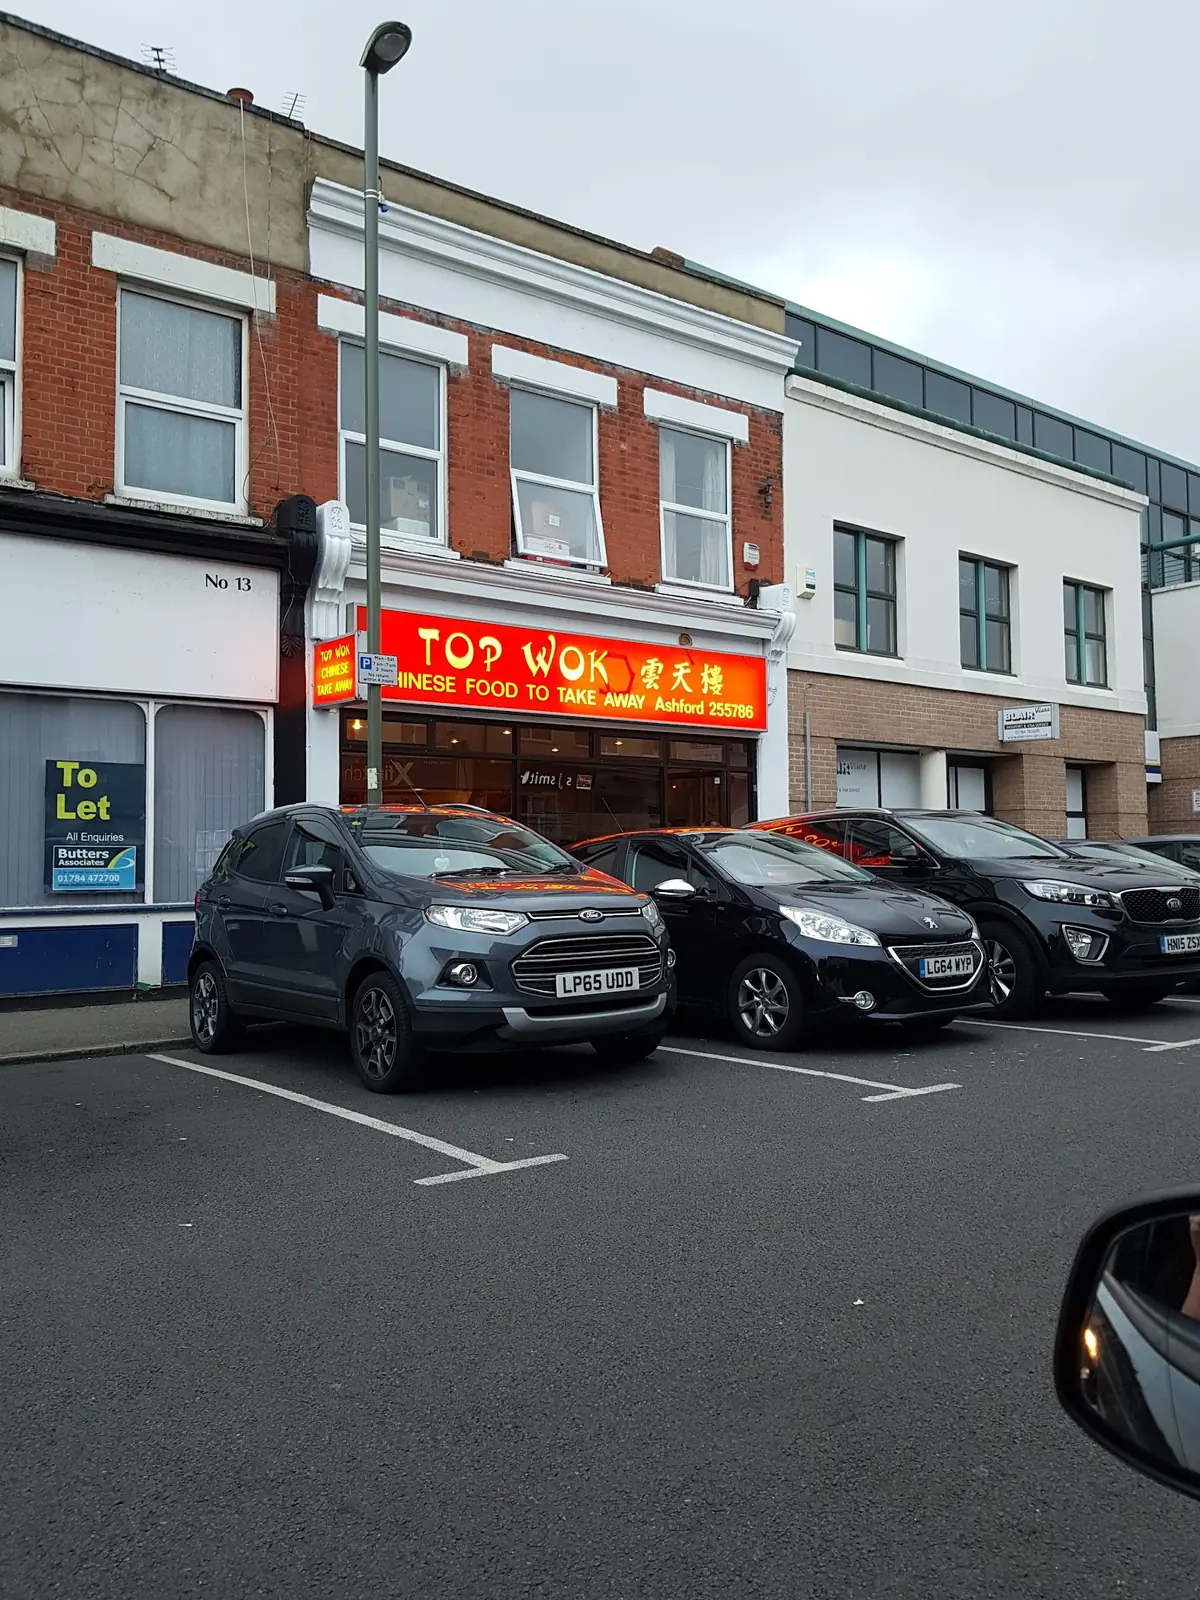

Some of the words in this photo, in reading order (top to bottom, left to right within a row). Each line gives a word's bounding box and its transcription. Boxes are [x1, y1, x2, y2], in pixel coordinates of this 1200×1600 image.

[205, 573, 228, 590] No
[235, 577, 252, 592] 13
[320, 649, 333, 663] TOP
[335, 644, 350, 658] WOK
[418, 627, 502, 672] TOP
[521, 634, 609, 685] WOK
[321, 661, 349, 679] CHINESE
[363, 658, 371, 669] P
[640, 657, 723, 696] 雲天樓
[317, 682, 333, 697] TAKE
[334, 678, 353, 693] AWAY
[398, 671, 456, 693] INESE
[466, 678, 519, 698] FOOD
[526, 684, 549, 701] TO
[557, 687, 597, 706] TAKE
[603, 691, 645, 710] AWAY
[655, 697, 704, 716] Ashford
[709, 702, 754, 719] 255786
[1005, 712, 1035, 722] BLAIR
[56, 761, 97, 788] To
[56, 794, 110, 821] Let
[66, 832, 78, 841] All
[81, 832, 124, 843] Enquiries
[58, 848, 109, 859] Butters
[926, 960, 952, 975] LG64
[954, 957, 971, 972] WYP
[562, 973, 601, 993] LP65
[606, 971, 633, 989] UDD
